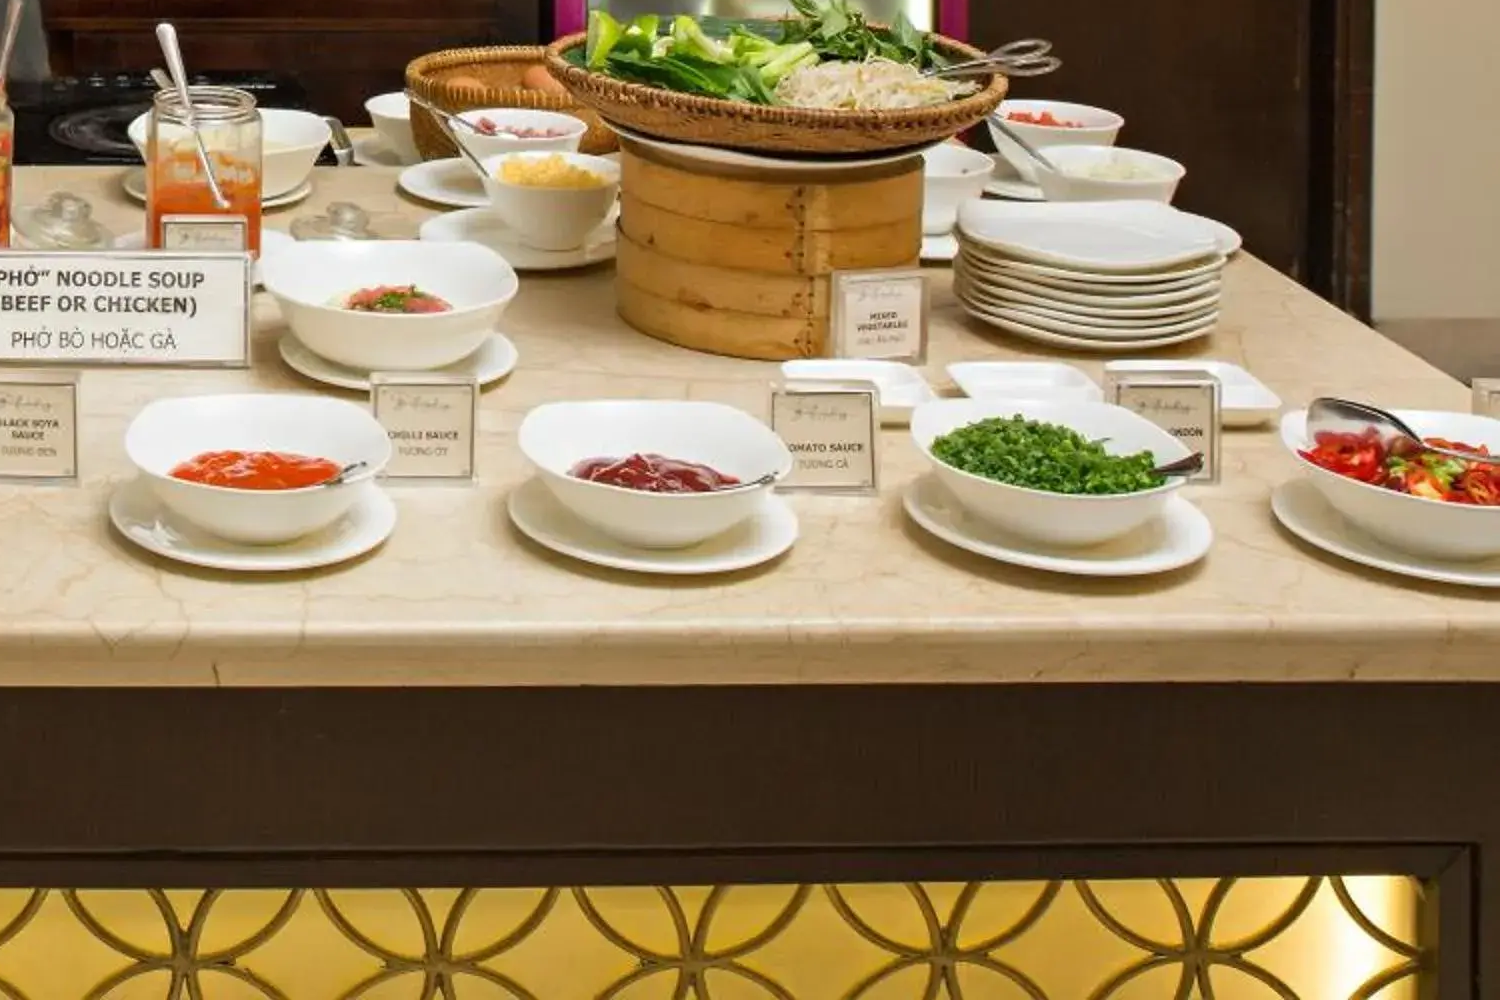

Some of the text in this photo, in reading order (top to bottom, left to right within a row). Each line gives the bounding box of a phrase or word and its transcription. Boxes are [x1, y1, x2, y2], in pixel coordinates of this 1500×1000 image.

[56, 271, 141, 288] NOODLE
[148, 271, 205, 289] SOUP
[57, 296, 87, 312] OR
[94, 297, 198, 317] CHICKEN)
[787, 443, 863, 453] OMATO SAUCE
